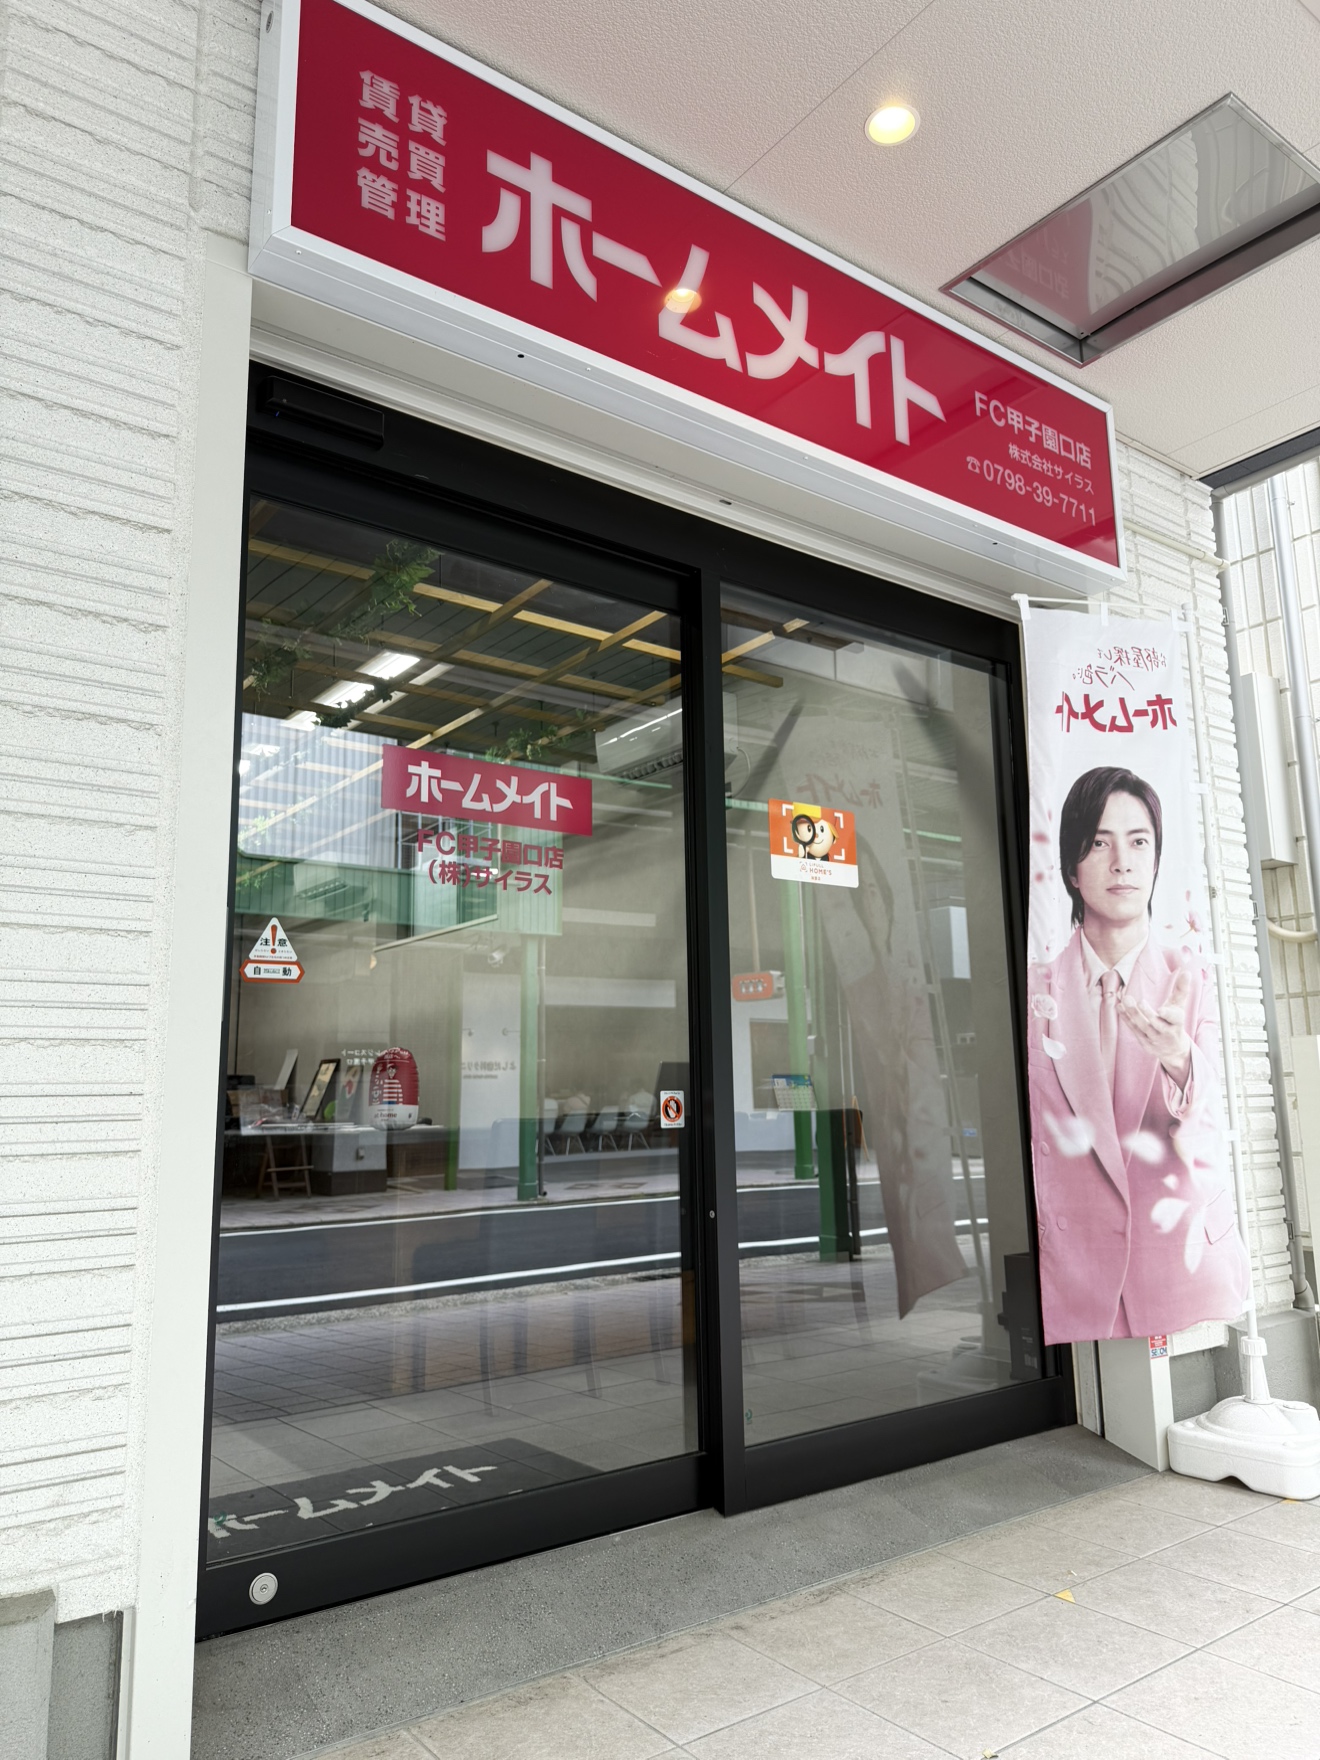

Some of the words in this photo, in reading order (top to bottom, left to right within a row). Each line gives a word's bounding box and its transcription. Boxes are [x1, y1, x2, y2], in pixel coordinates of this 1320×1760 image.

[358, 69, 448, 146] 賃貸
[357, 117, 447, 194] 売買
[356, 168, 447, 242] 管理
[481, 149, 946, 446] ホームメイト
[975, 390, 1092, 470] FC甲子園口店
[982, 458, 1097, 527] 0798-39-7711
[1008, 442, 1094, 496] 株式会社サイラス
[406, 761, 573, 821] ホームメイト
[417, 829, 564, 869] FC甲子園口店
[428, 859, 552, 895] (株)サイラス
